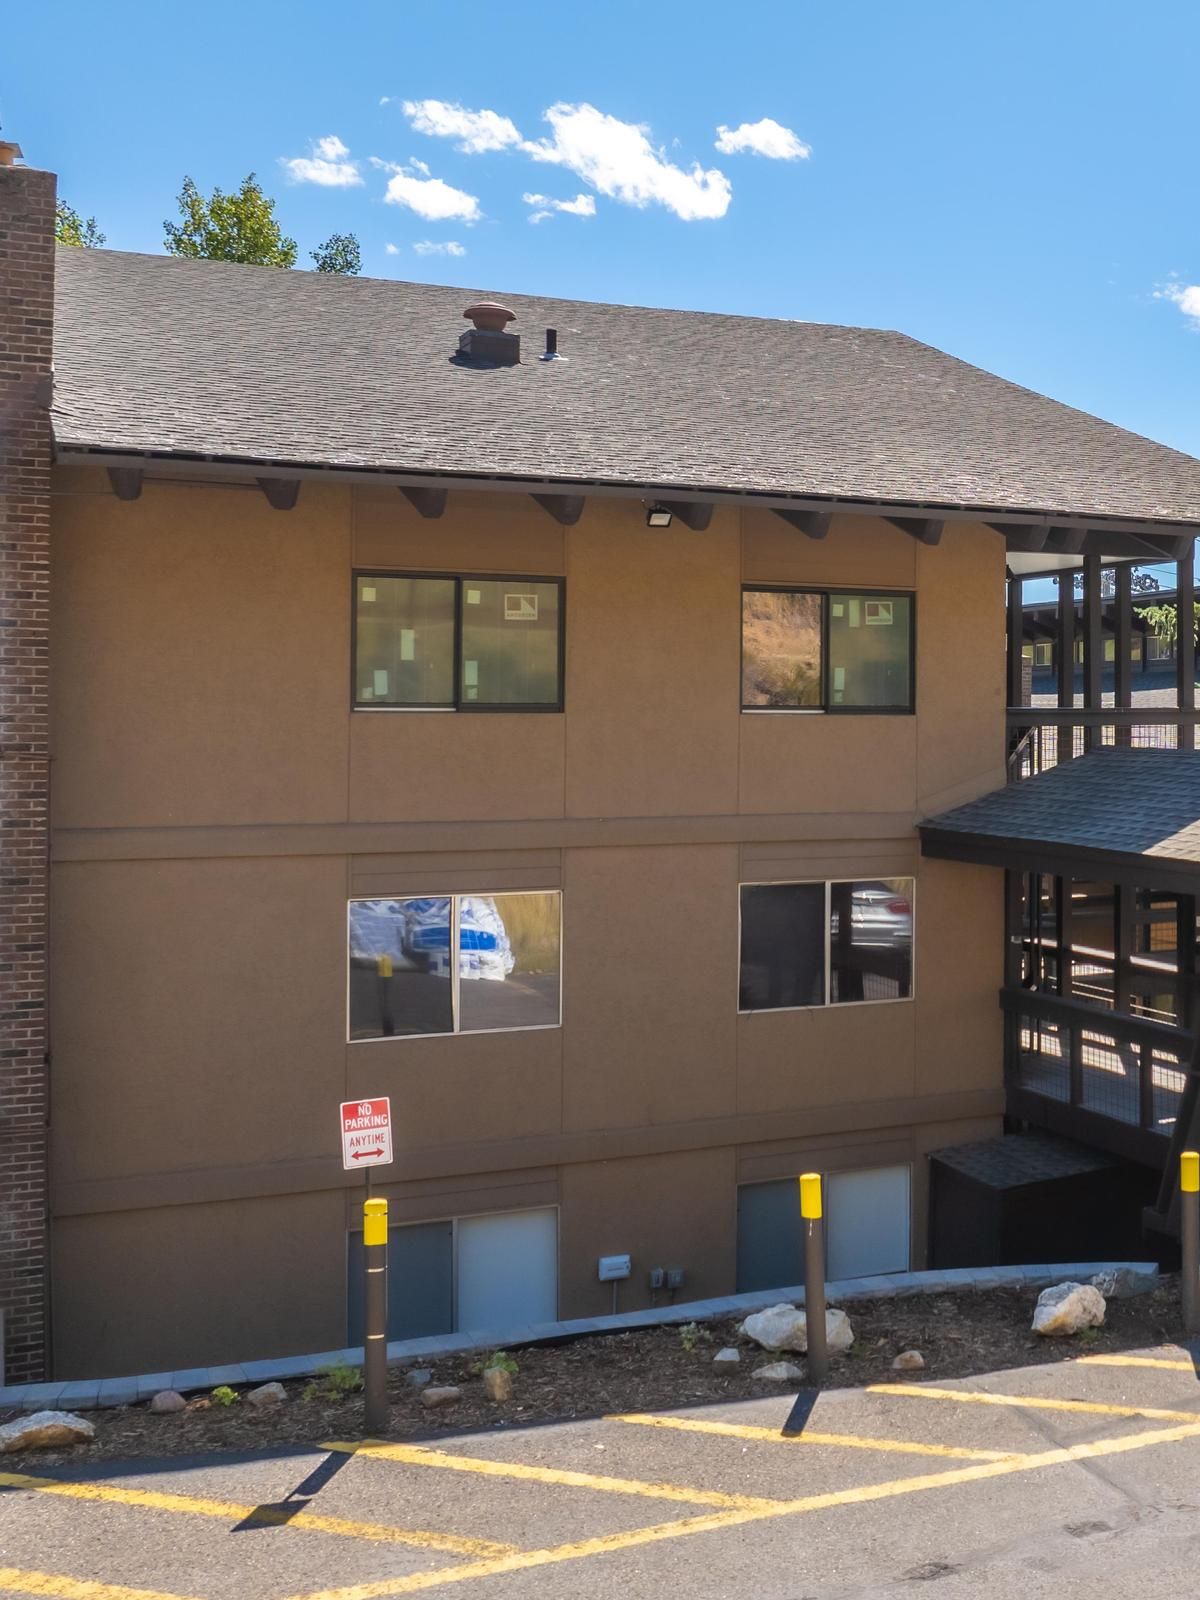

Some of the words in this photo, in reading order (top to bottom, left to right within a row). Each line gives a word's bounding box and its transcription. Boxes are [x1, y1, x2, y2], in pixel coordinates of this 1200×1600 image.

[358, 1104, 372, 1116] NO
[345, 1114, 387, 1130] PARKING
[350, 1133, 385, 1148] ANYTIME
